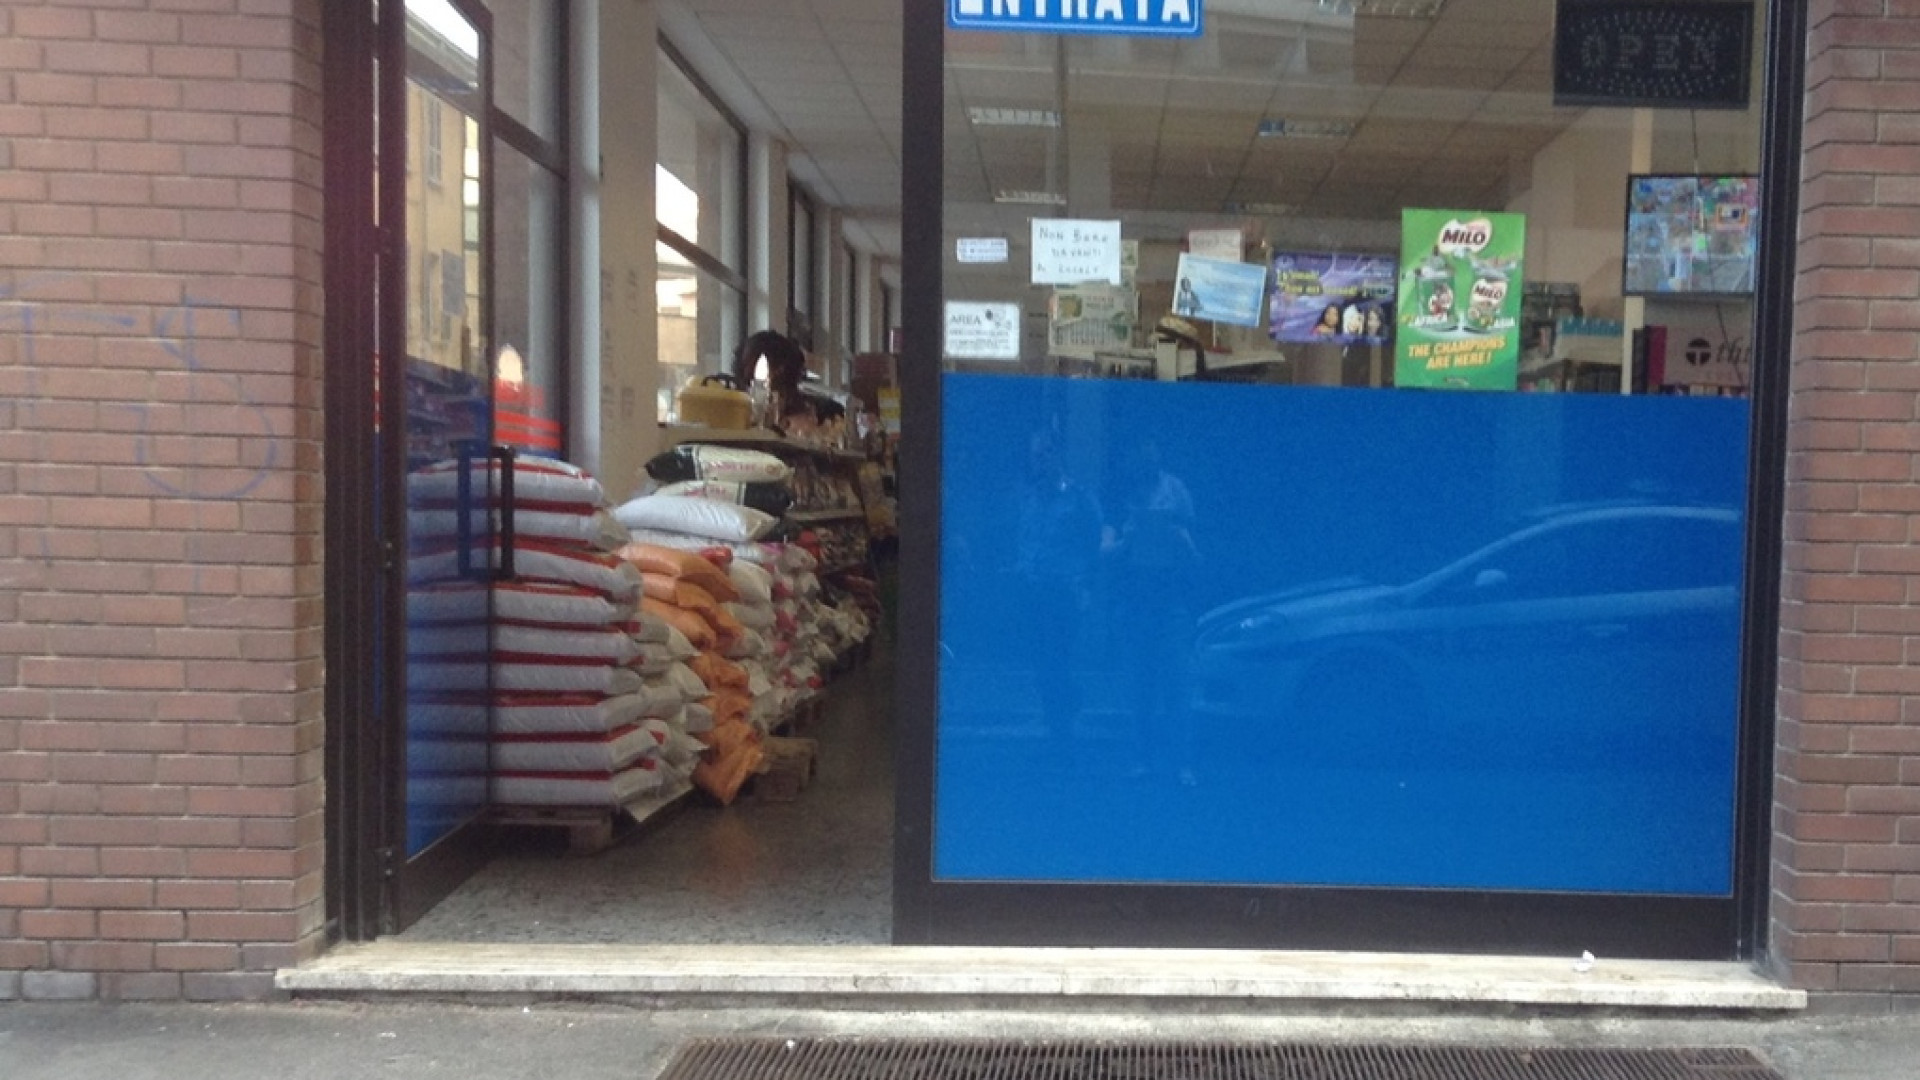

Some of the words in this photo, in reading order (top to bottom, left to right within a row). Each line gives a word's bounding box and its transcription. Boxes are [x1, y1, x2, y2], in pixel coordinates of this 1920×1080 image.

[1582, 32, 1721, 71] OPEN
[1442, 229, 1486, 245] MILO
[950, 314, 982, 325] AREA
[1408, 343, 1430, 358] THE
[1435, 337, 1505, 354] CHAMPIONS
[1426, 355, 1450, 370] ARE
